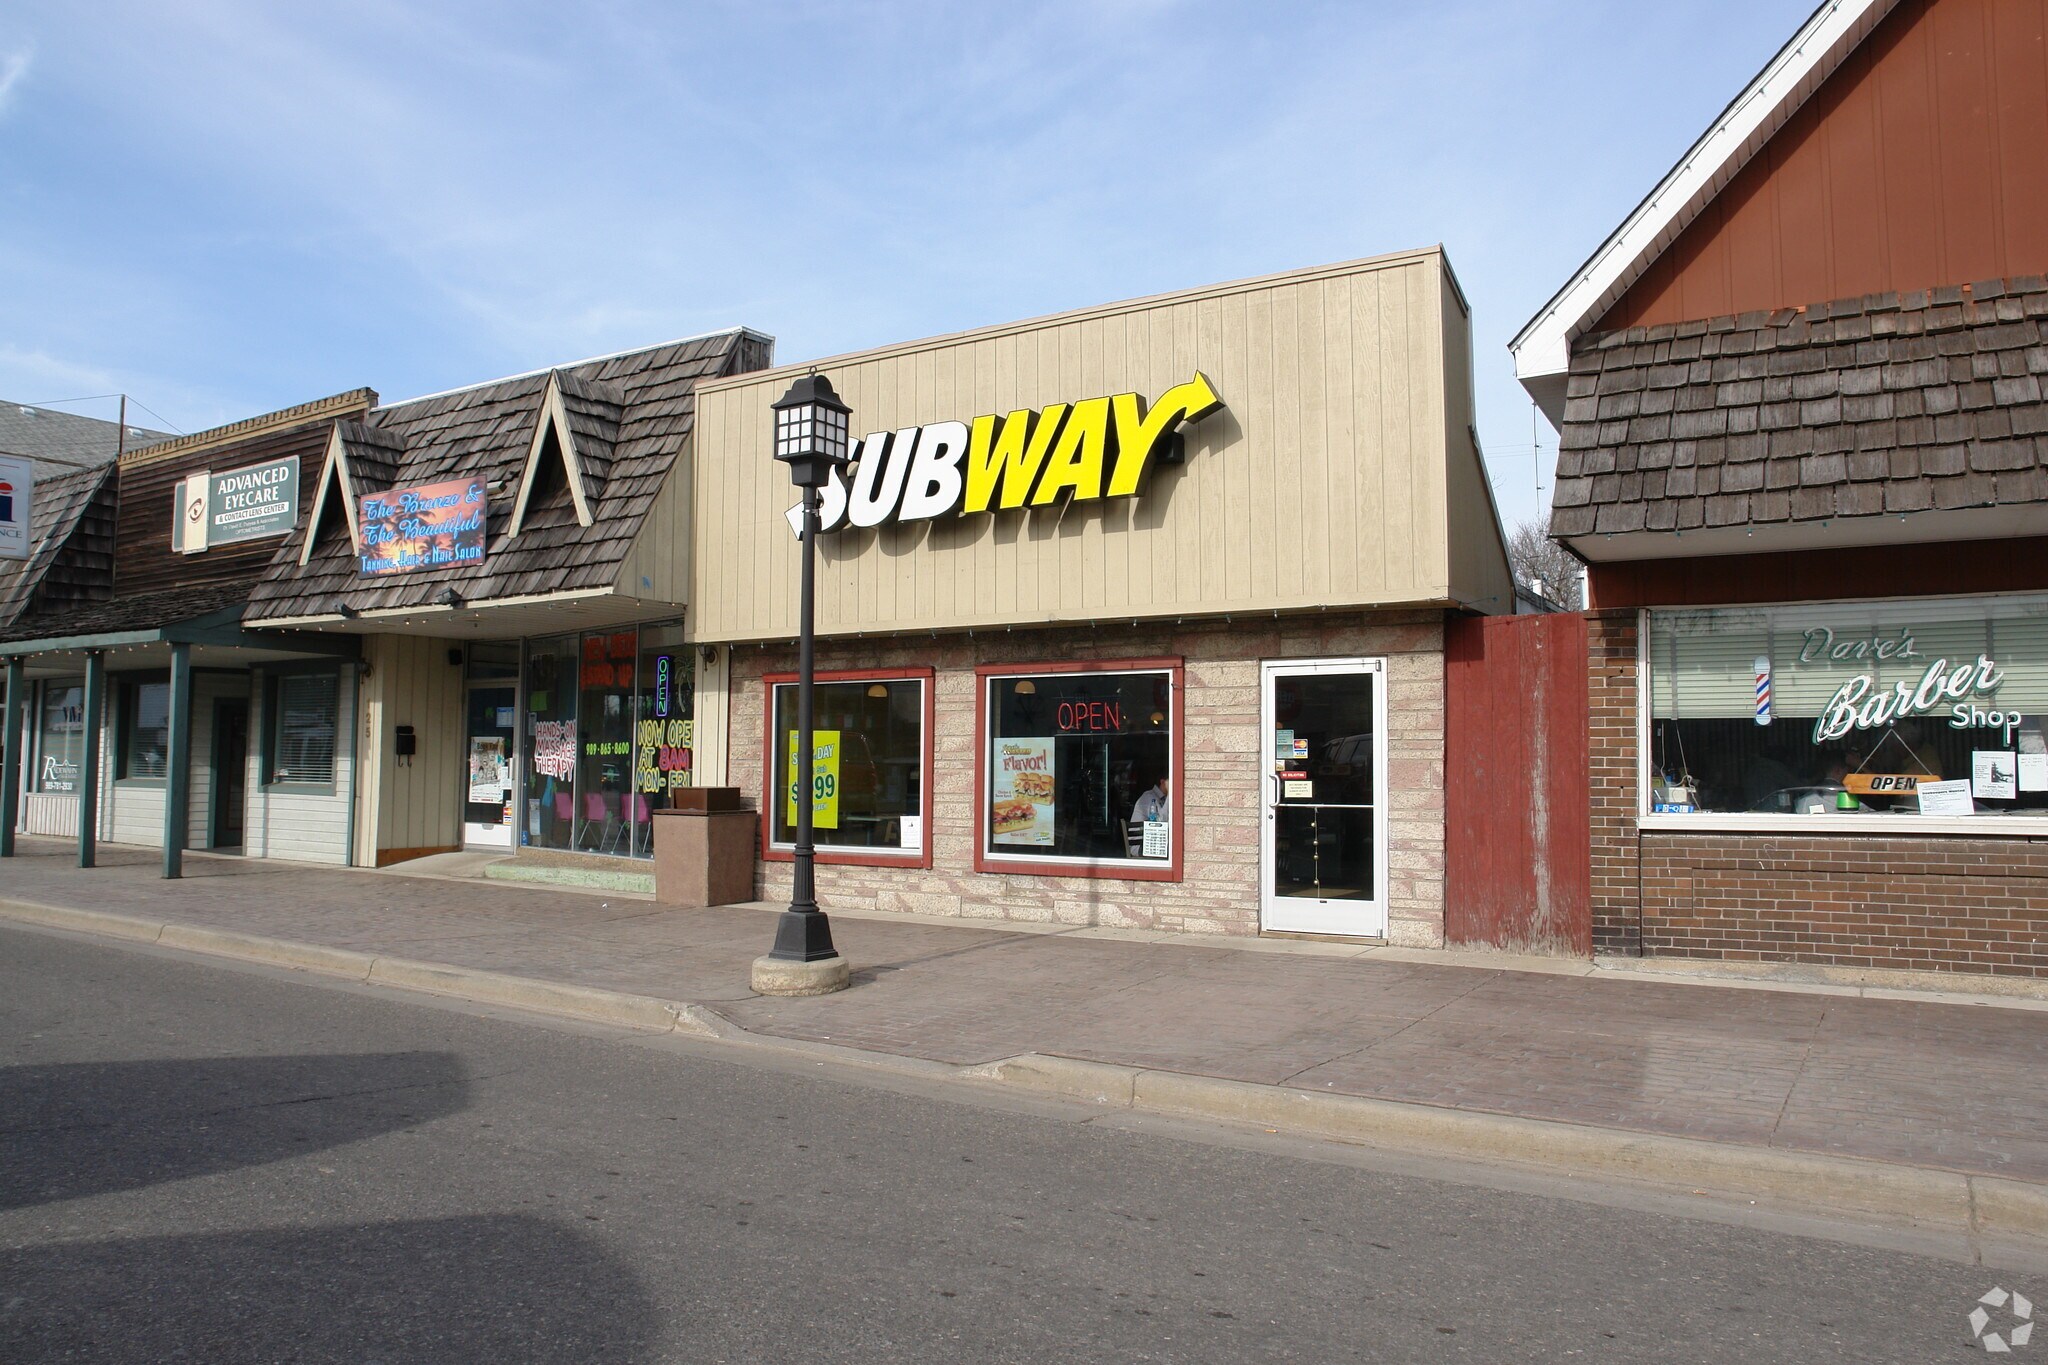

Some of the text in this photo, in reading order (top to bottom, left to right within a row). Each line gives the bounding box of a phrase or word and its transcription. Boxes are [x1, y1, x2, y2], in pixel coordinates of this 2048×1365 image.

[217, 466, 290, 495] ADVANCED
[225, 485, 279, 510] EYECARE
[363, 484, 484, 520] The Bronze &
[224, 511, 248, 521] CONTACT
[248, 507, 262, 517] LENS
[263, 503, 285, 514] CENTER
[363, 509, 481, 545] The Beautiful
[424, 555, 432, 564] &
[1800, 624, 1921, 663] Dave's
[658, 659, 668, 713] OPEN
[1812, 653, 2004, 745] Barber
[535, 719, 576, 739] HANDS-ON
[1058, 702, 1120, 730] OPEN
[1950, 703, 2022, 747] Shop
[638, 719, 665, 749] NOW
[535, 738, 576, 759] MASSAGE
[639, 743, 689, 771] AT 8AM
[817, 743, 835, 760] DAY
[1003, 749, 1047, 771] Flavor!
[535, 757, 575, 782] THERAPY
[1871, 777, 1917, 790] OPEN
